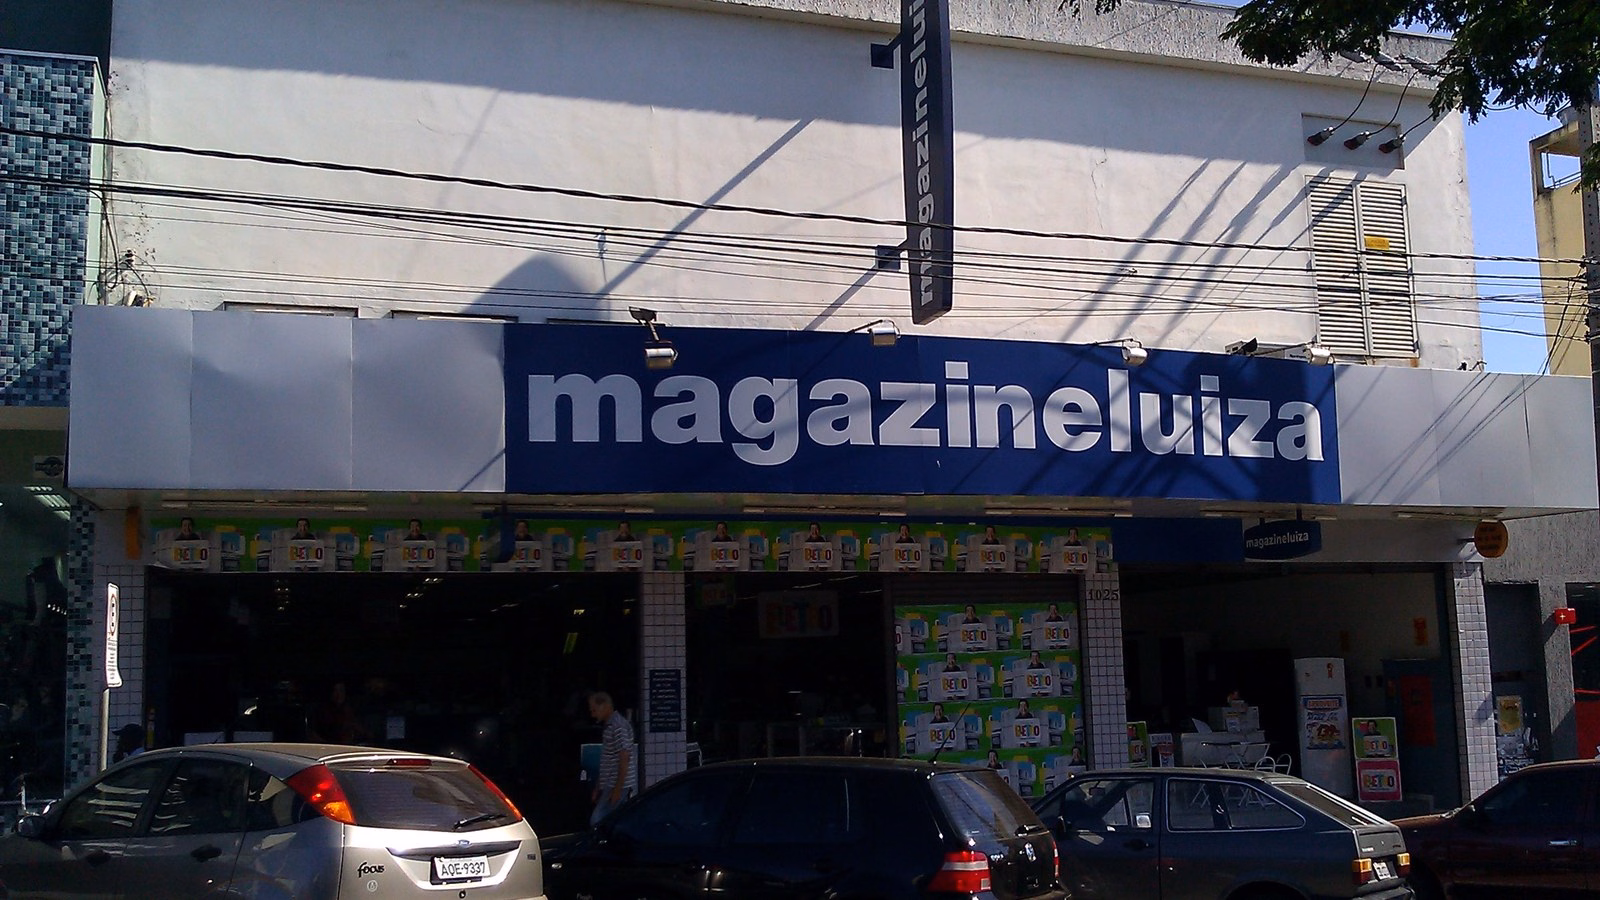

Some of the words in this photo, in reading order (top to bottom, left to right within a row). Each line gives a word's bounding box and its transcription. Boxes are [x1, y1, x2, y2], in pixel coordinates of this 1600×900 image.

[528, 361, 1324, 467] magazineluiza
[1246, 531, 1309, 549] magazineluiza
[1088, 589, 1119, 600] 1025
